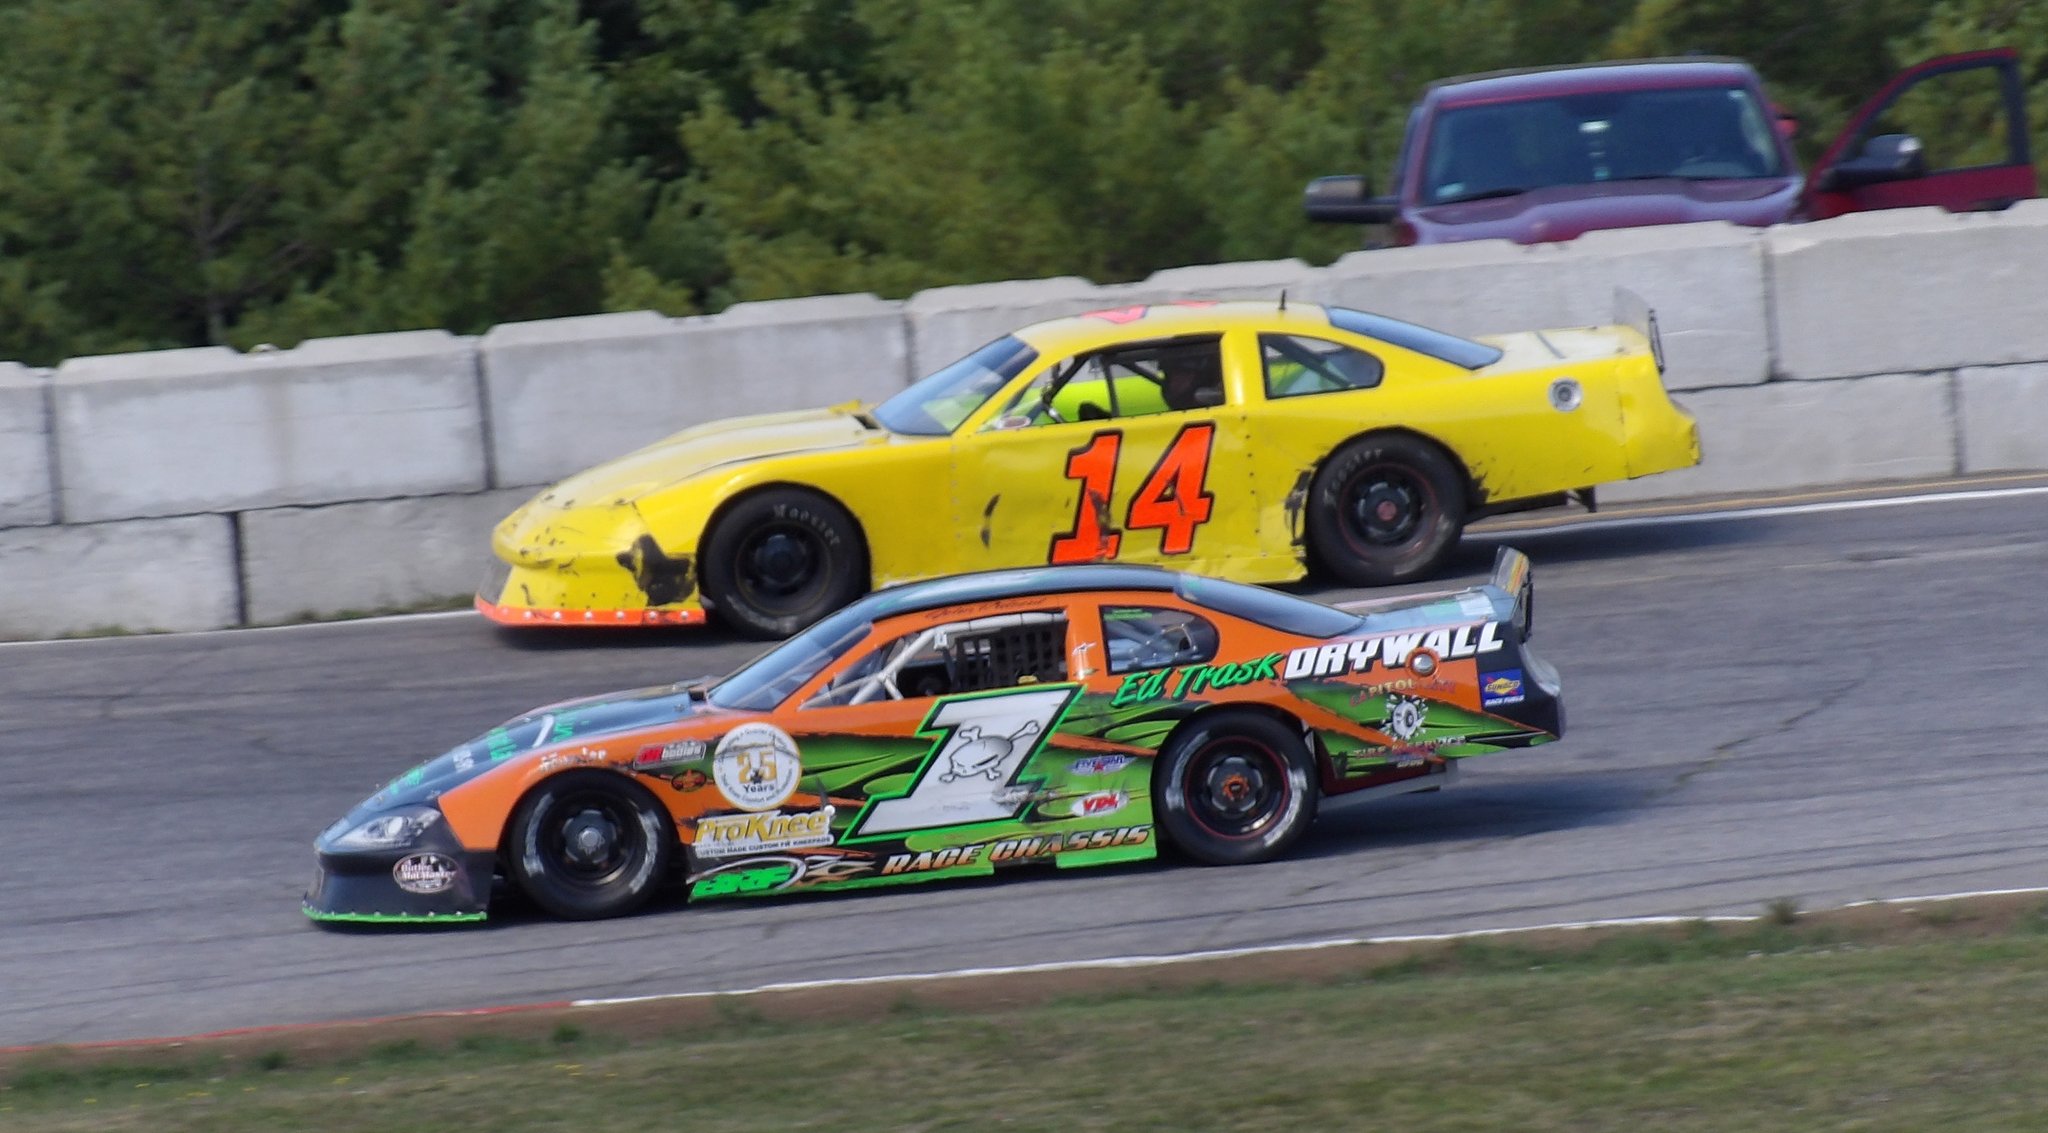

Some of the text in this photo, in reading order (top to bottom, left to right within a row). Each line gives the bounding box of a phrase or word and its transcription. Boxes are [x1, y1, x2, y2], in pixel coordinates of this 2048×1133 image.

[1048, 420, 1216, 566] 14
[1110, 621, 1504, 707] Ed Trask DRYWALL
[1486, 680, 1520, 691] SUNOCO
[737, 750, 777, 784] 25
[842, 683, 1087, 844] 1
[744, 784, 775, 793] Years
[694, 812, 828, 843] ProKnee
[748, 842, 779, 852] CUSTOM
[881, 824, 1153, 875] RACE CHASSIS
